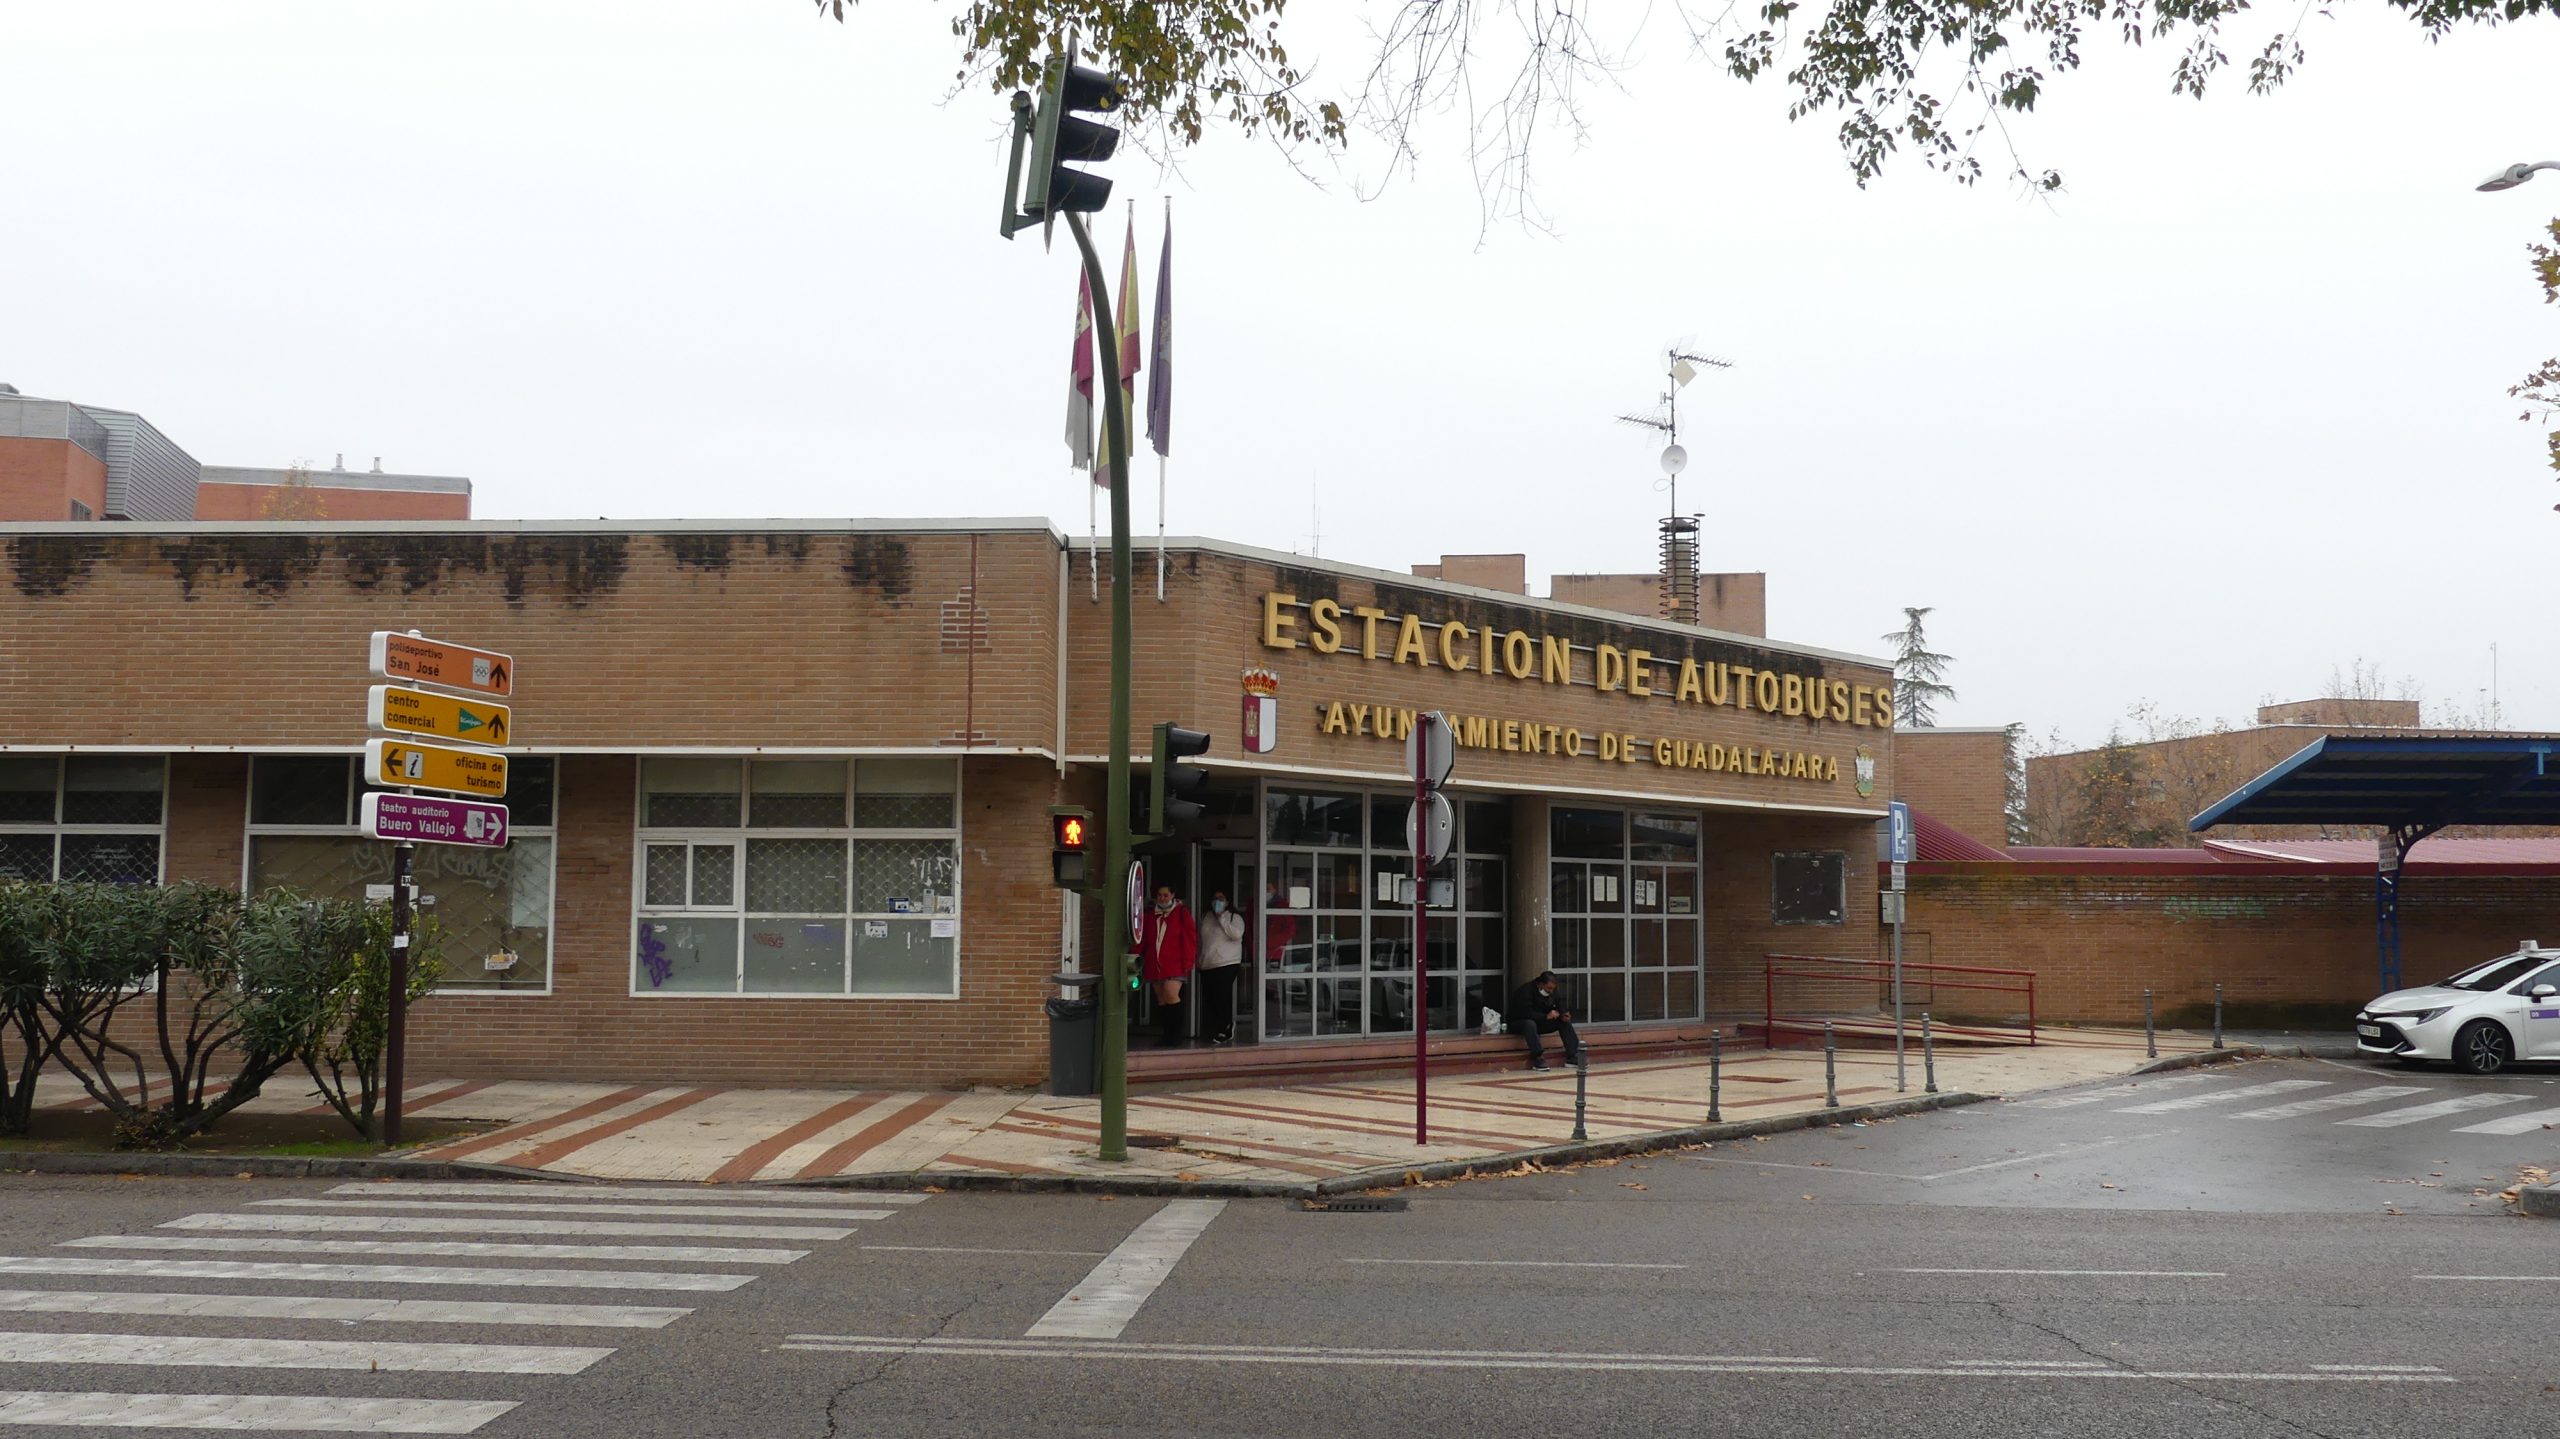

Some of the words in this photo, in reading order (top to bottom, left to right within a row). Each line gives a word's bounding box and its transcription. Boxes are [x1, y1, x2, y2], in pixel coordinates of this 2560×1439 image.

[389, 641, 443, 660] polideportivo
[1264, 591, 1570, 685] ESTACION
[1596, 644, 1650, 696] DE
[1675, 658, 1892, 728] AUTOBUSES
[390, 656, 410, 671] San
[416, 661, 440, 677] José
[387, 693, 420, 708] centro
[387, 711, 435, 729] comercial
[1322, 701, 1581, 757] AYUNAMIENTO
[1600, 731, 1636, 763] DE
[1653, 737, 1839, 781] GUADALAJARA
[456, 757, 487, 770] oficina
[491, 761, 503, 773] de
[467, 775, 501, 790] turismo
[380, 801, 408, 814] teatro
[412, 806, 449, 818] auditorio
[380, 816, 412, 832] Buero
[419, 819, 456, 837] Vallejo
[1894, 810, 1904, 854] P
